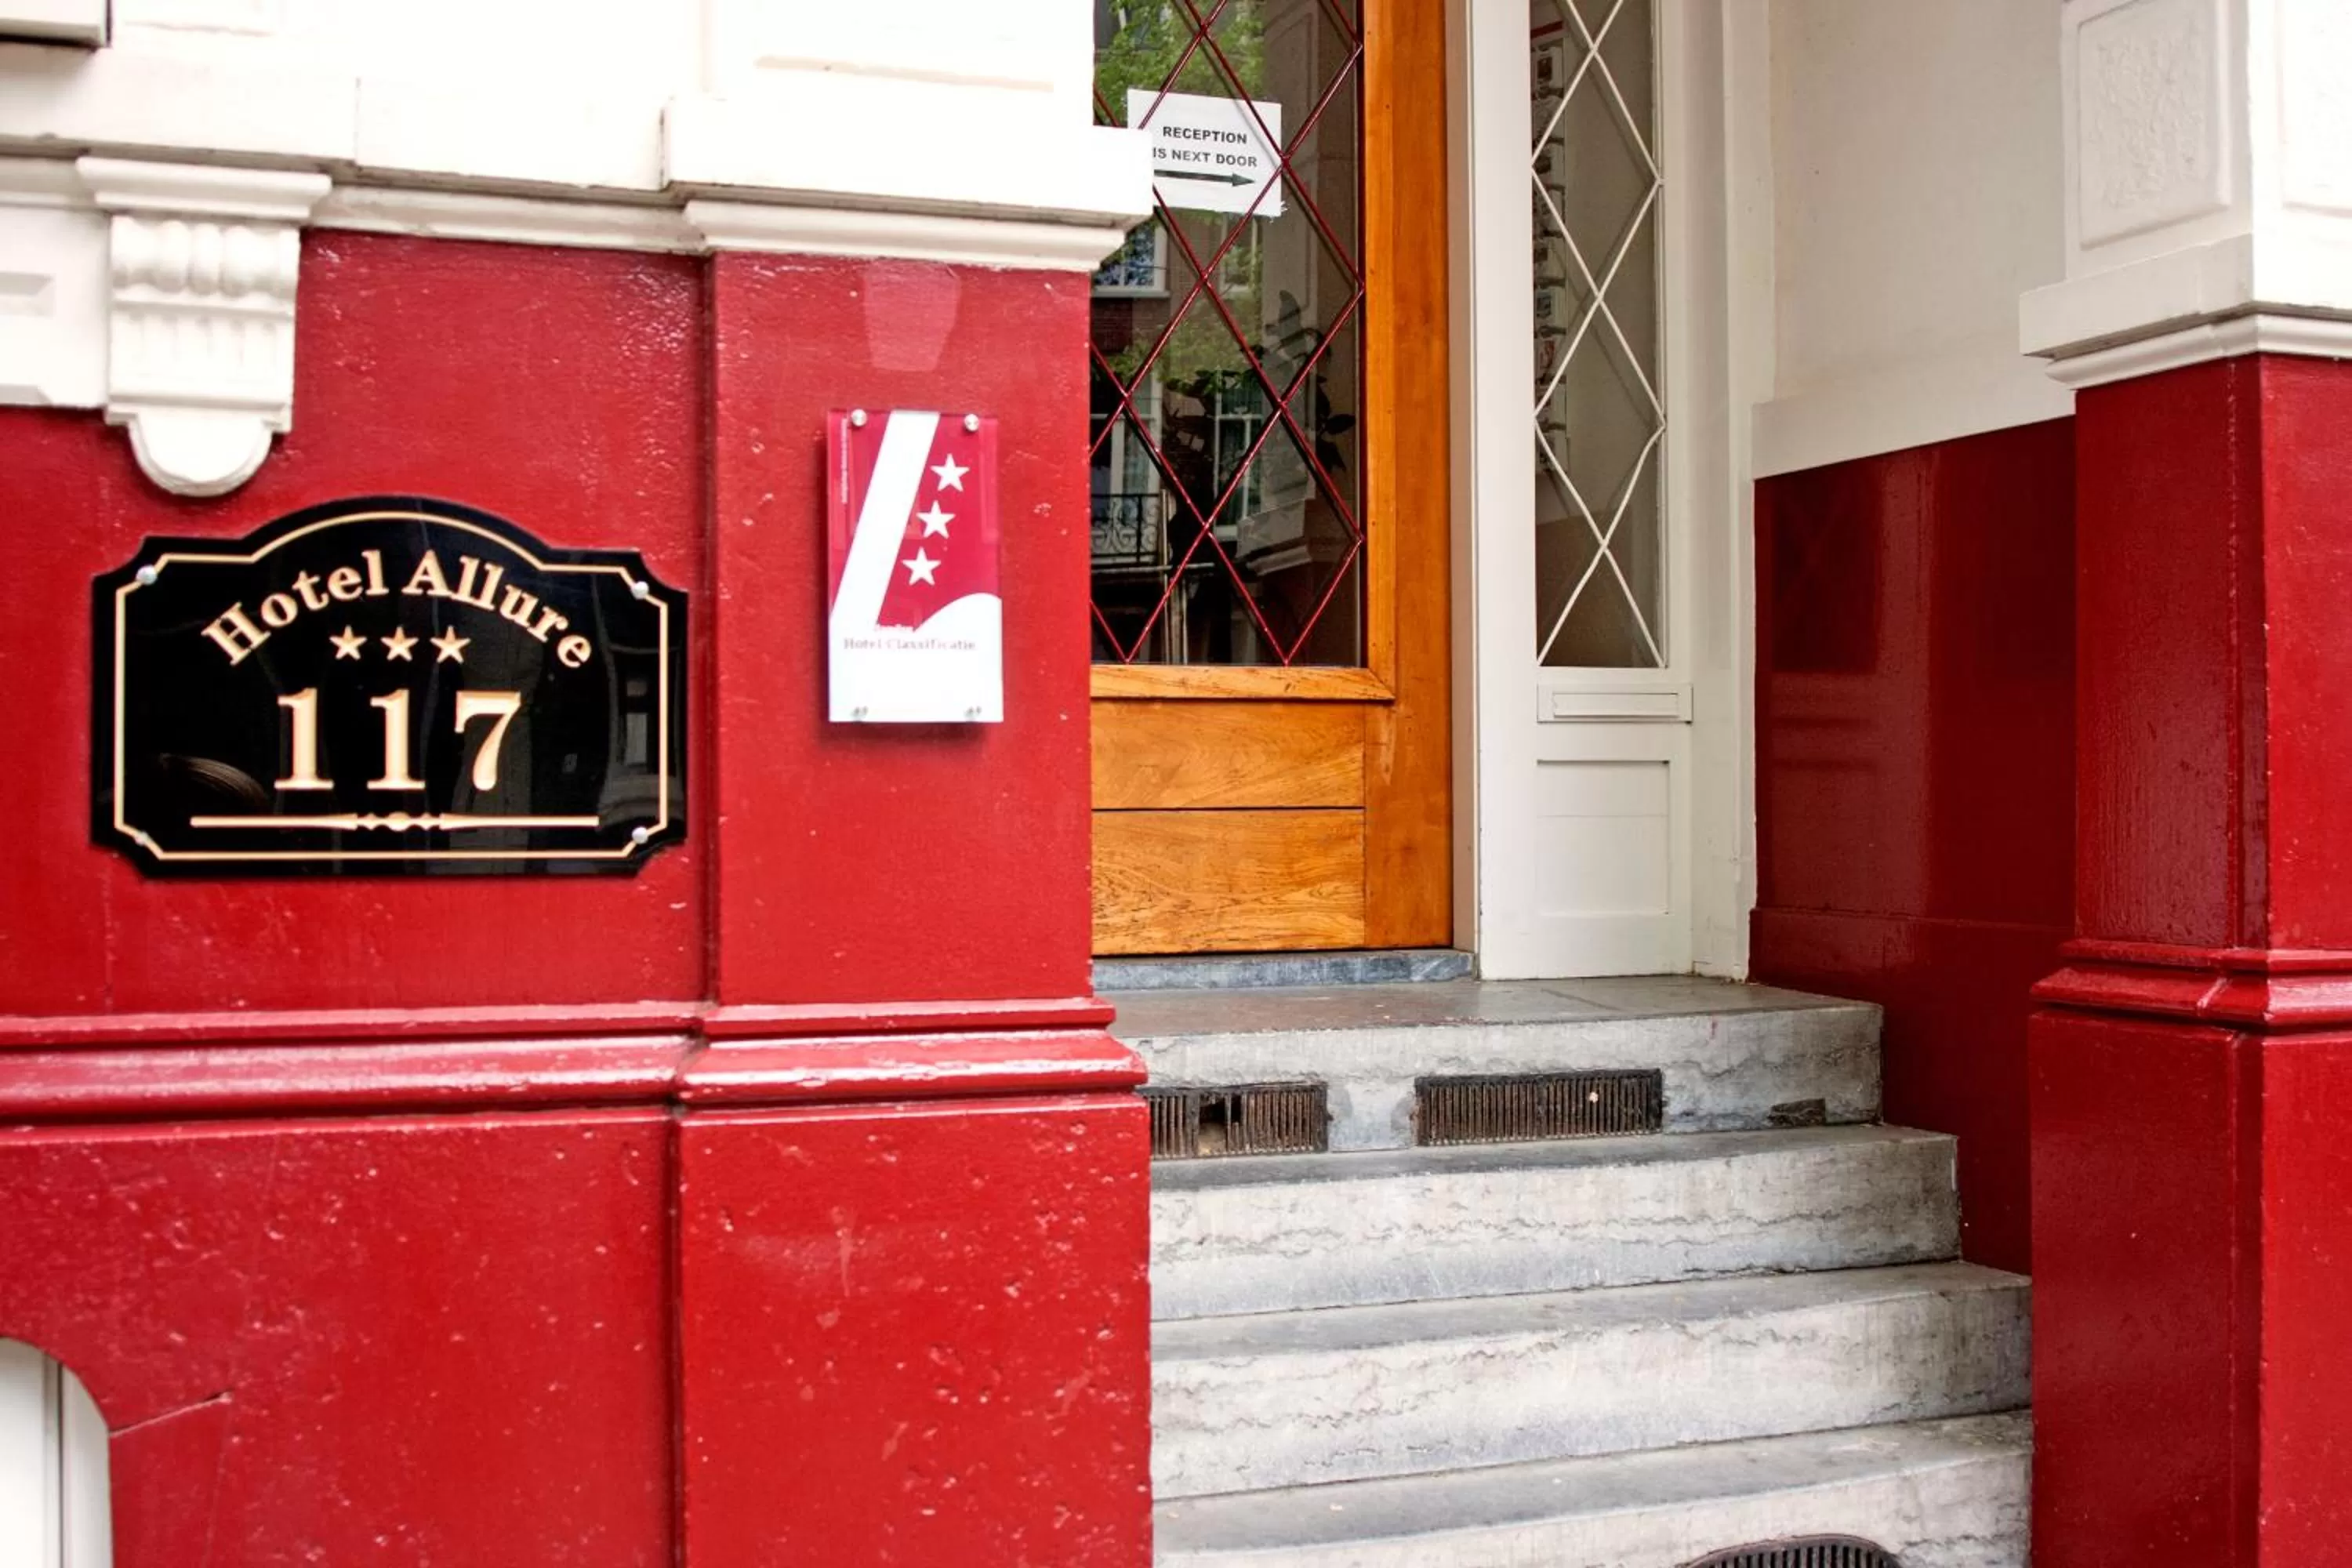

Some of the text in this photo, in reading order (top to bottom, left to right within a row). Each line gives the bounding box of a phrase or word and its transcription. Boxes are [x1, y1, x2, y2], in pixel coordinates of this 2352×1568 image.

[1152, 147, 1258, 167] IS NEXT DOOR
[1163, 126, 1247, 144] RECEPTION
[201, 550, 591, 668] Hotel Allure
[274, 687, 521, 791] 117
